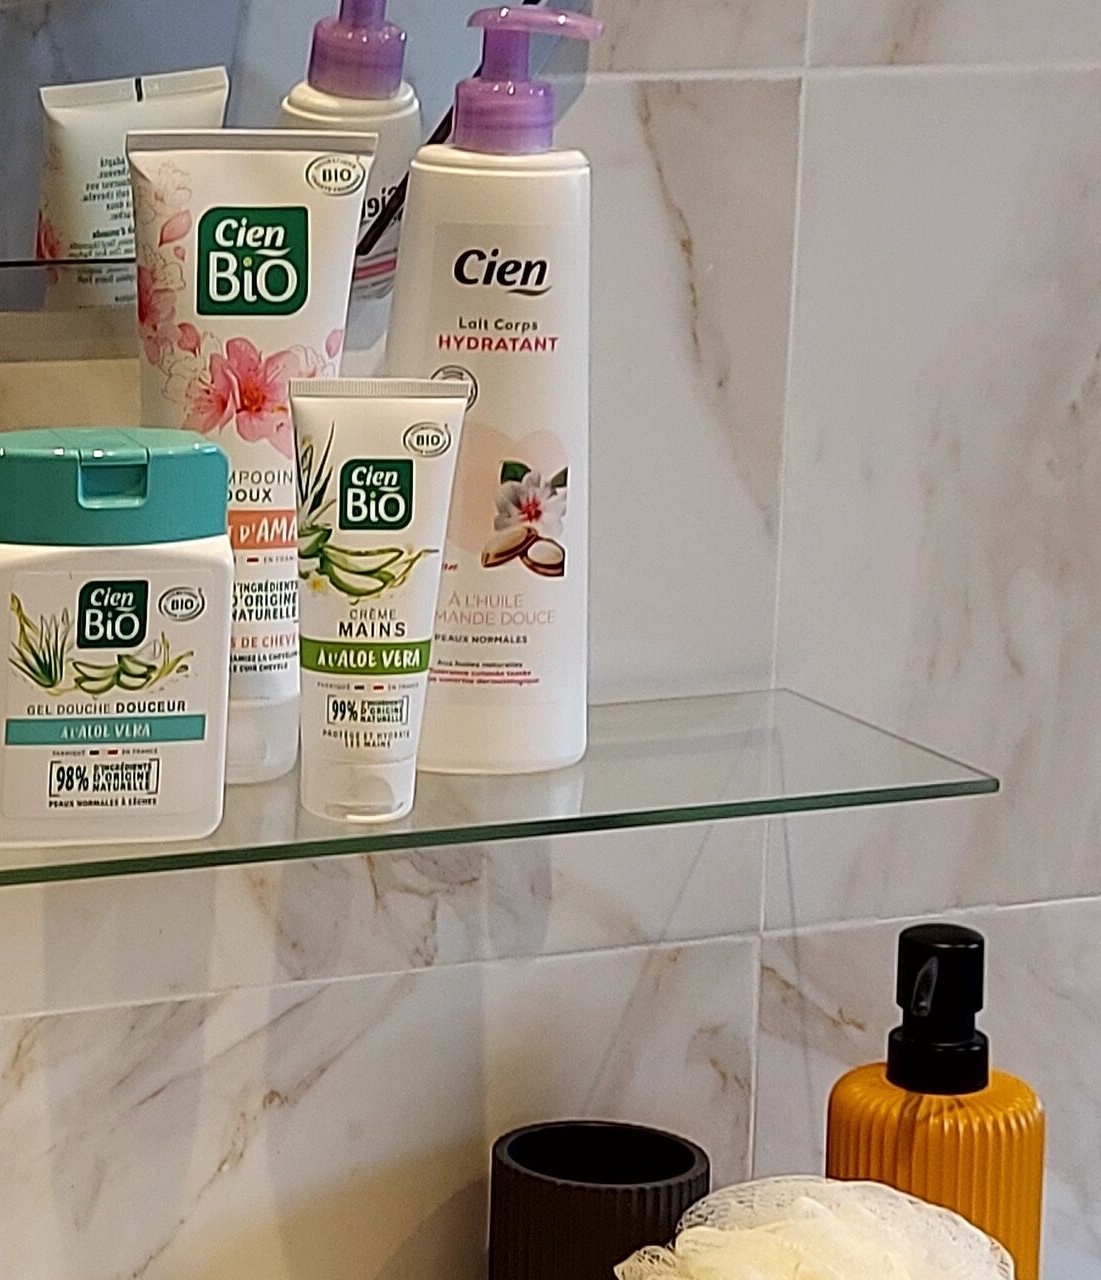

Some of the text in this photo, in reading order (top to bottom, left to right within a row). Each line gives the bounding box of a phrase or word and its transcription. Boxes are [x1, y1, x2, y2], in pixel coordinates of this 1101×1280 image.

[322, 168, 351, 182] BIO
[215, 217, 286, 248] Cien
[454, 248, 549, 287] Cien
[459, 316, 538, 334] Lait Corps
[438, 334, 559, 352] HYDRATANT
[416, 434, 441, 447] BIO
[228, 470, 293, 485] MPOOIN
[351, 465, 399, 487] Cien
[240, 516, 297, 545] D'AMA
[90, 587, 134, 607] Cien
[170, 598, 194, 611] BIO
[465, 593, 524, 608] L'HUILE
[436, 609, 557, 626] MANDE DOUCE
[338, 621, 406, 638] MAINS
[262, 633, 296, 648] CHEV
[434, 633, 528, 644] PEAUX NORMALES
[382, 648, 421, 668] VERA
[27, 700, 186, 715] GEL DOUCHE DOUCEUR
[332, 699, 358, 722] 99%
[114, 722, 150, 738] VERA
[56, 765, 89, 791] 98%
